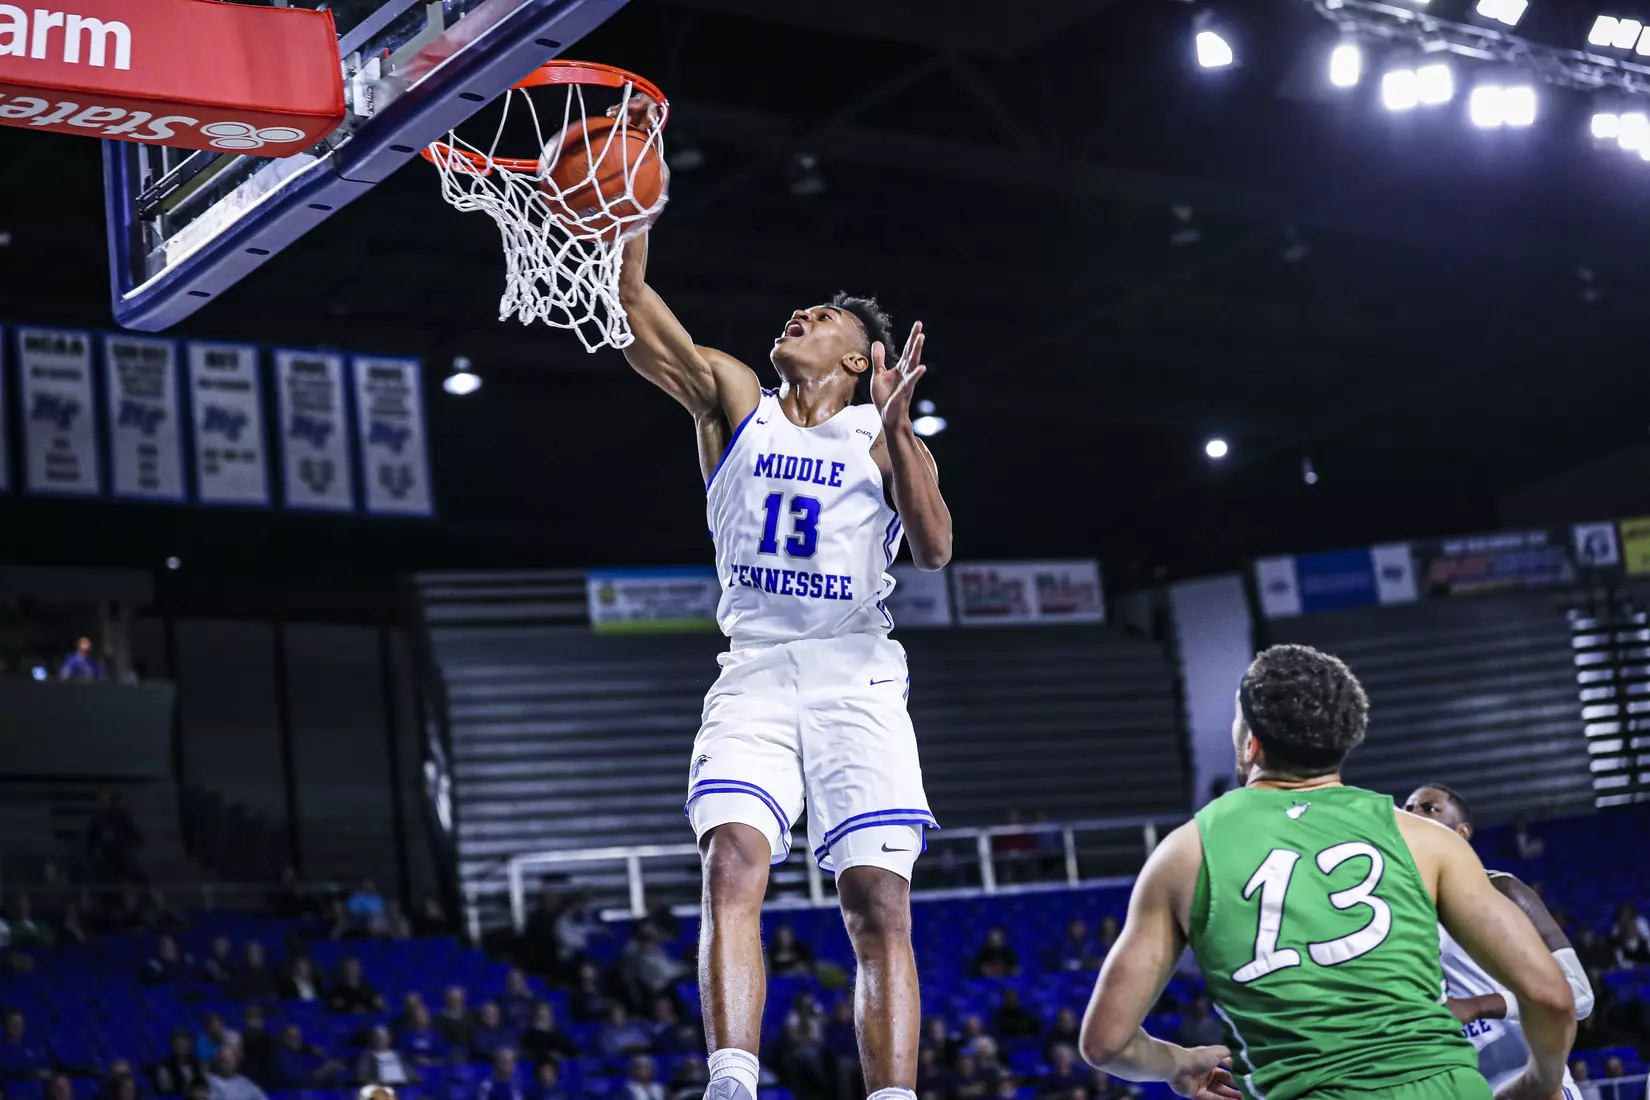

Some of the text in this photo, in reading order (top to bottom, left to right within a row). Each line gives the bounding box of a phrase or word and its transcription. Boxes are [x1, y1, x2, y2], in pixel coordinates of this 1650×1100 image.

[753, 453, 845, 487] MIDDLE
[757, 491, 823, 559] 13
[728, 564, 853, 600] TENNESSEE
[1232, 841, 1392, 984] 13
